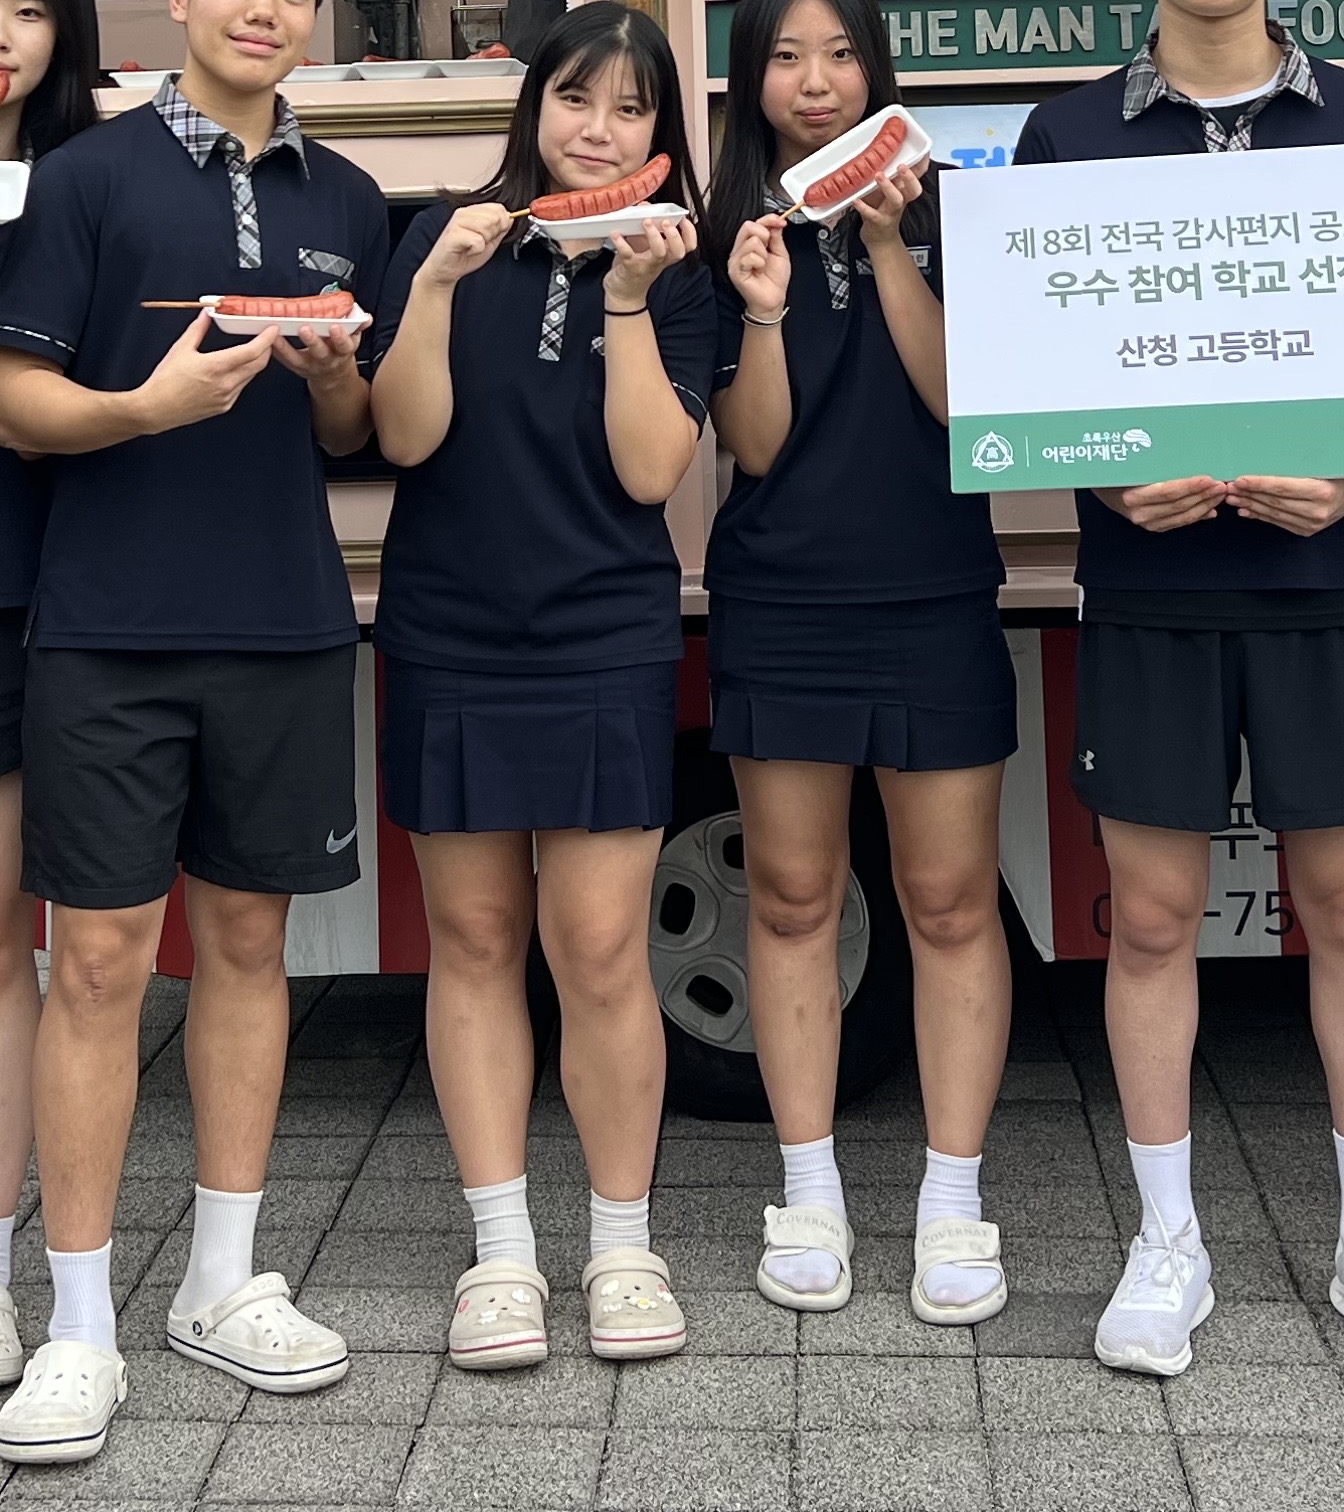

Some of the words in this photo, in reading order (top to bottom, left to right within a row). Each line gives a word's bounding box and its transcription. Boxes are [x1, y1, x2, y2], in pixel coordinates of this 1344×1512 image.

[881, 9, 959, 57] HE
[974, 5, 1096, 55] MAN
[1100, 220, 1165, 255] 전국
[1171, 211, 1302, 252] 감사편지
[1044, 268, 1120, 308] 우수
[1127, 262, 1203, 305] 참여
[1211, 259, 1292, 299] 학교
[1115, 333, 1179, 369] 산청
[1185, 328, 1316, 364] 고등학교
[1041, 443, 1129, 464] 어린이재단
[1081, 431, 1122, 443] 초록우산
